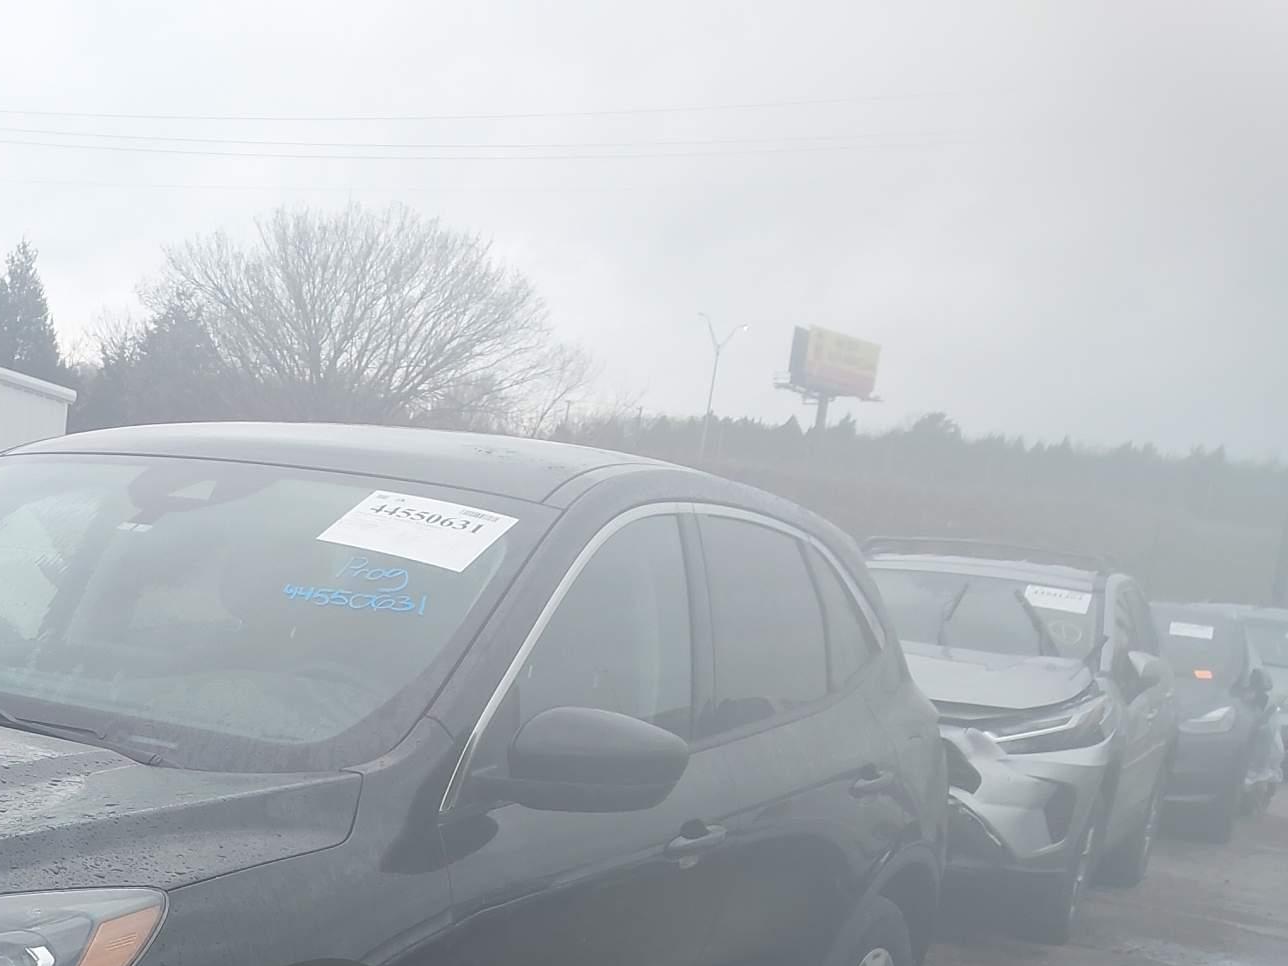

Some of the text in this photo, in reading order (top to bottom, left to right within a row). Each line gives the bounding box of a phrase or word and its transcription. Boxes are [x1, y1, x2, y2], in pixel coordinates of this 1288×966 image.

[370, 504, 485, 534] 44550631
[336, 556, 409, 593] Prog
[282, 583, 428, 616] 44550631
